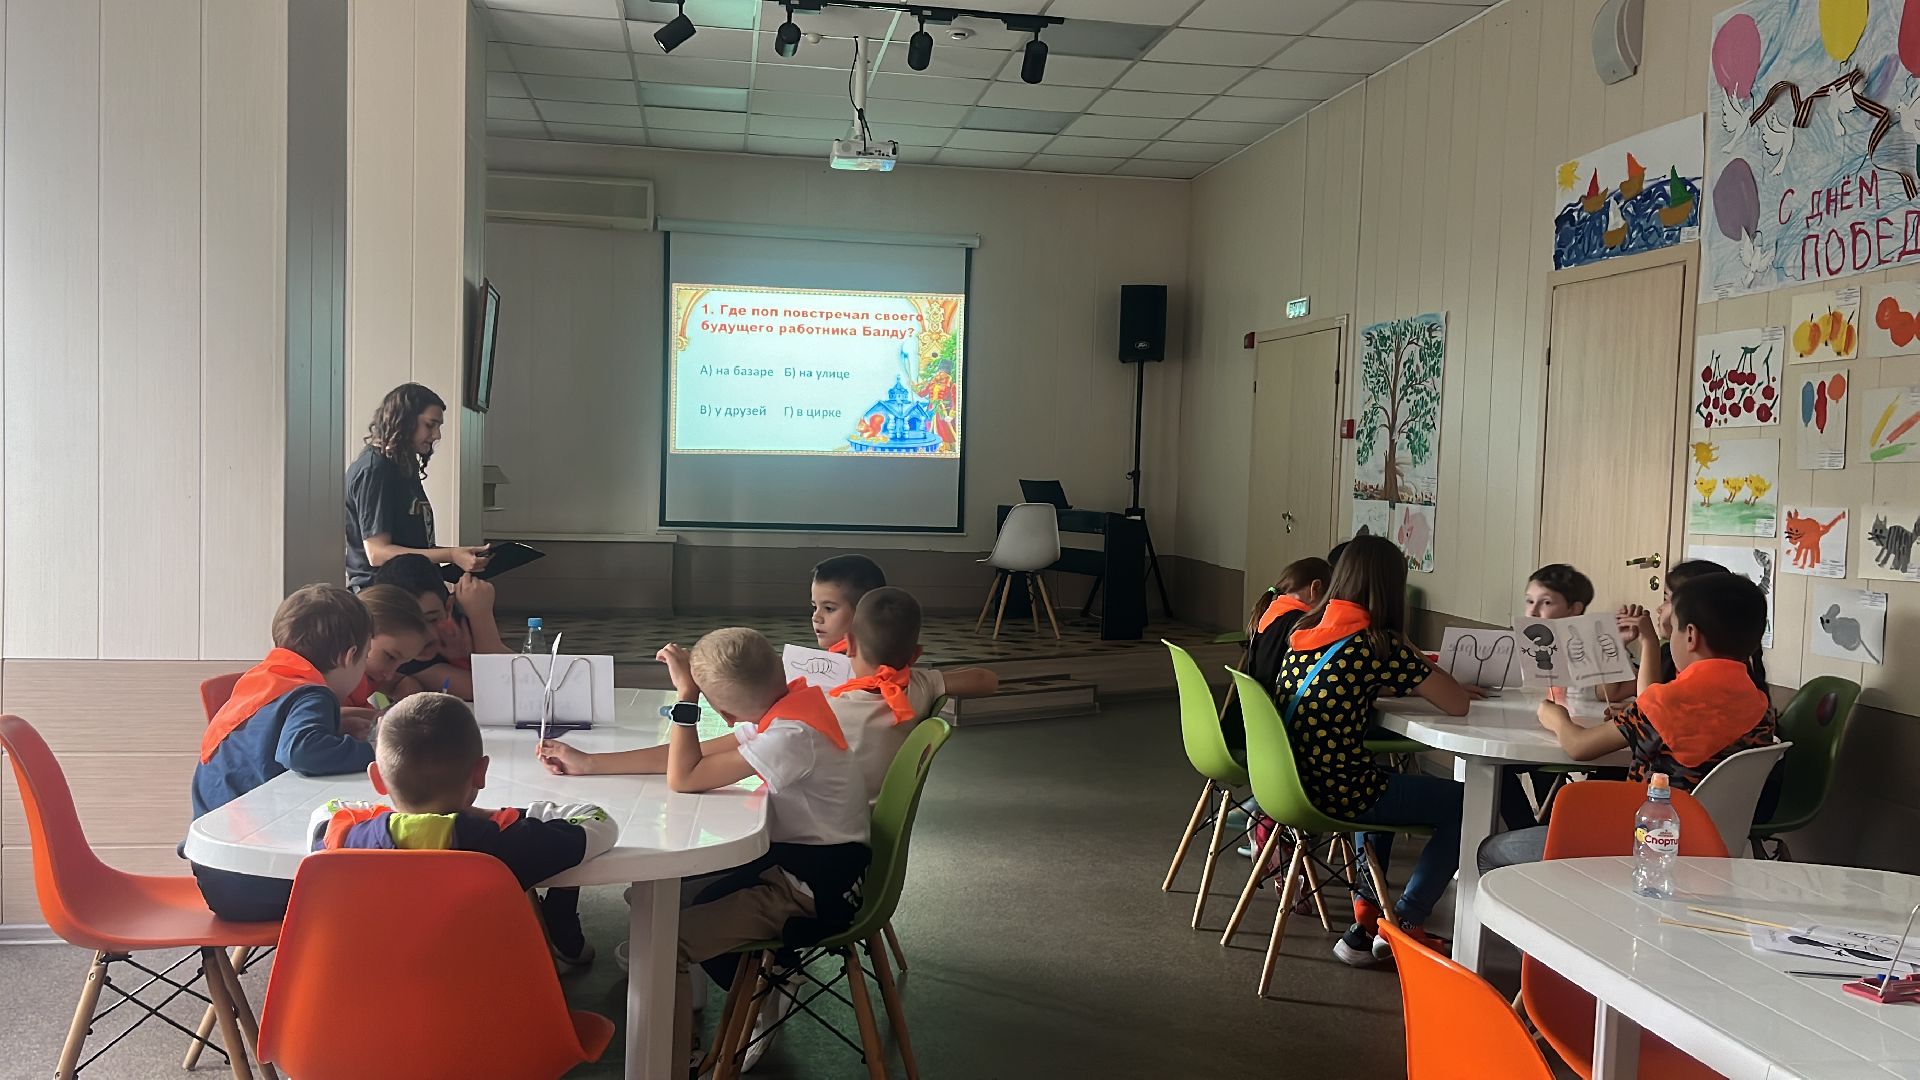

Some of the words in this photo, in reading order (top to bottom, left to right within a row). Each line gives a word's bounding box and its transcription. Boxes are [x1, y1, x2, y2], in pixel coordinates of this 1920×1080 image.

[1805, 169, 1881, 229] ДНЁМ
[701, 304, 714, 315] 1.
[719, 304, 747, 317] Где
[752, 307, 779, 317] поп
[783, 309, 870, 321] повстречал
[874, 312, 924, 323] своего
[701, 320, 774, 334] будущего
[779, 323, 857, 336] работника
[862, 327, 915, 339] Балду?
[700, 365, 712, 377] А)
[716, 367, 730, 376] на
[733, 366, 774, 379] базаре
[784, 368, 796, 379] Б)
[800, 369, 813, 378] на
[816, 369, 850, 380] улице
[700, 405, 712, 417] В)
[715, 407, 722, 417] у
[724, 406, 767, 418] друзей
[784, 406, 794, 418] Г)
[797, 408, 803, 417] в
[806, 408, 842, 419] цирке
